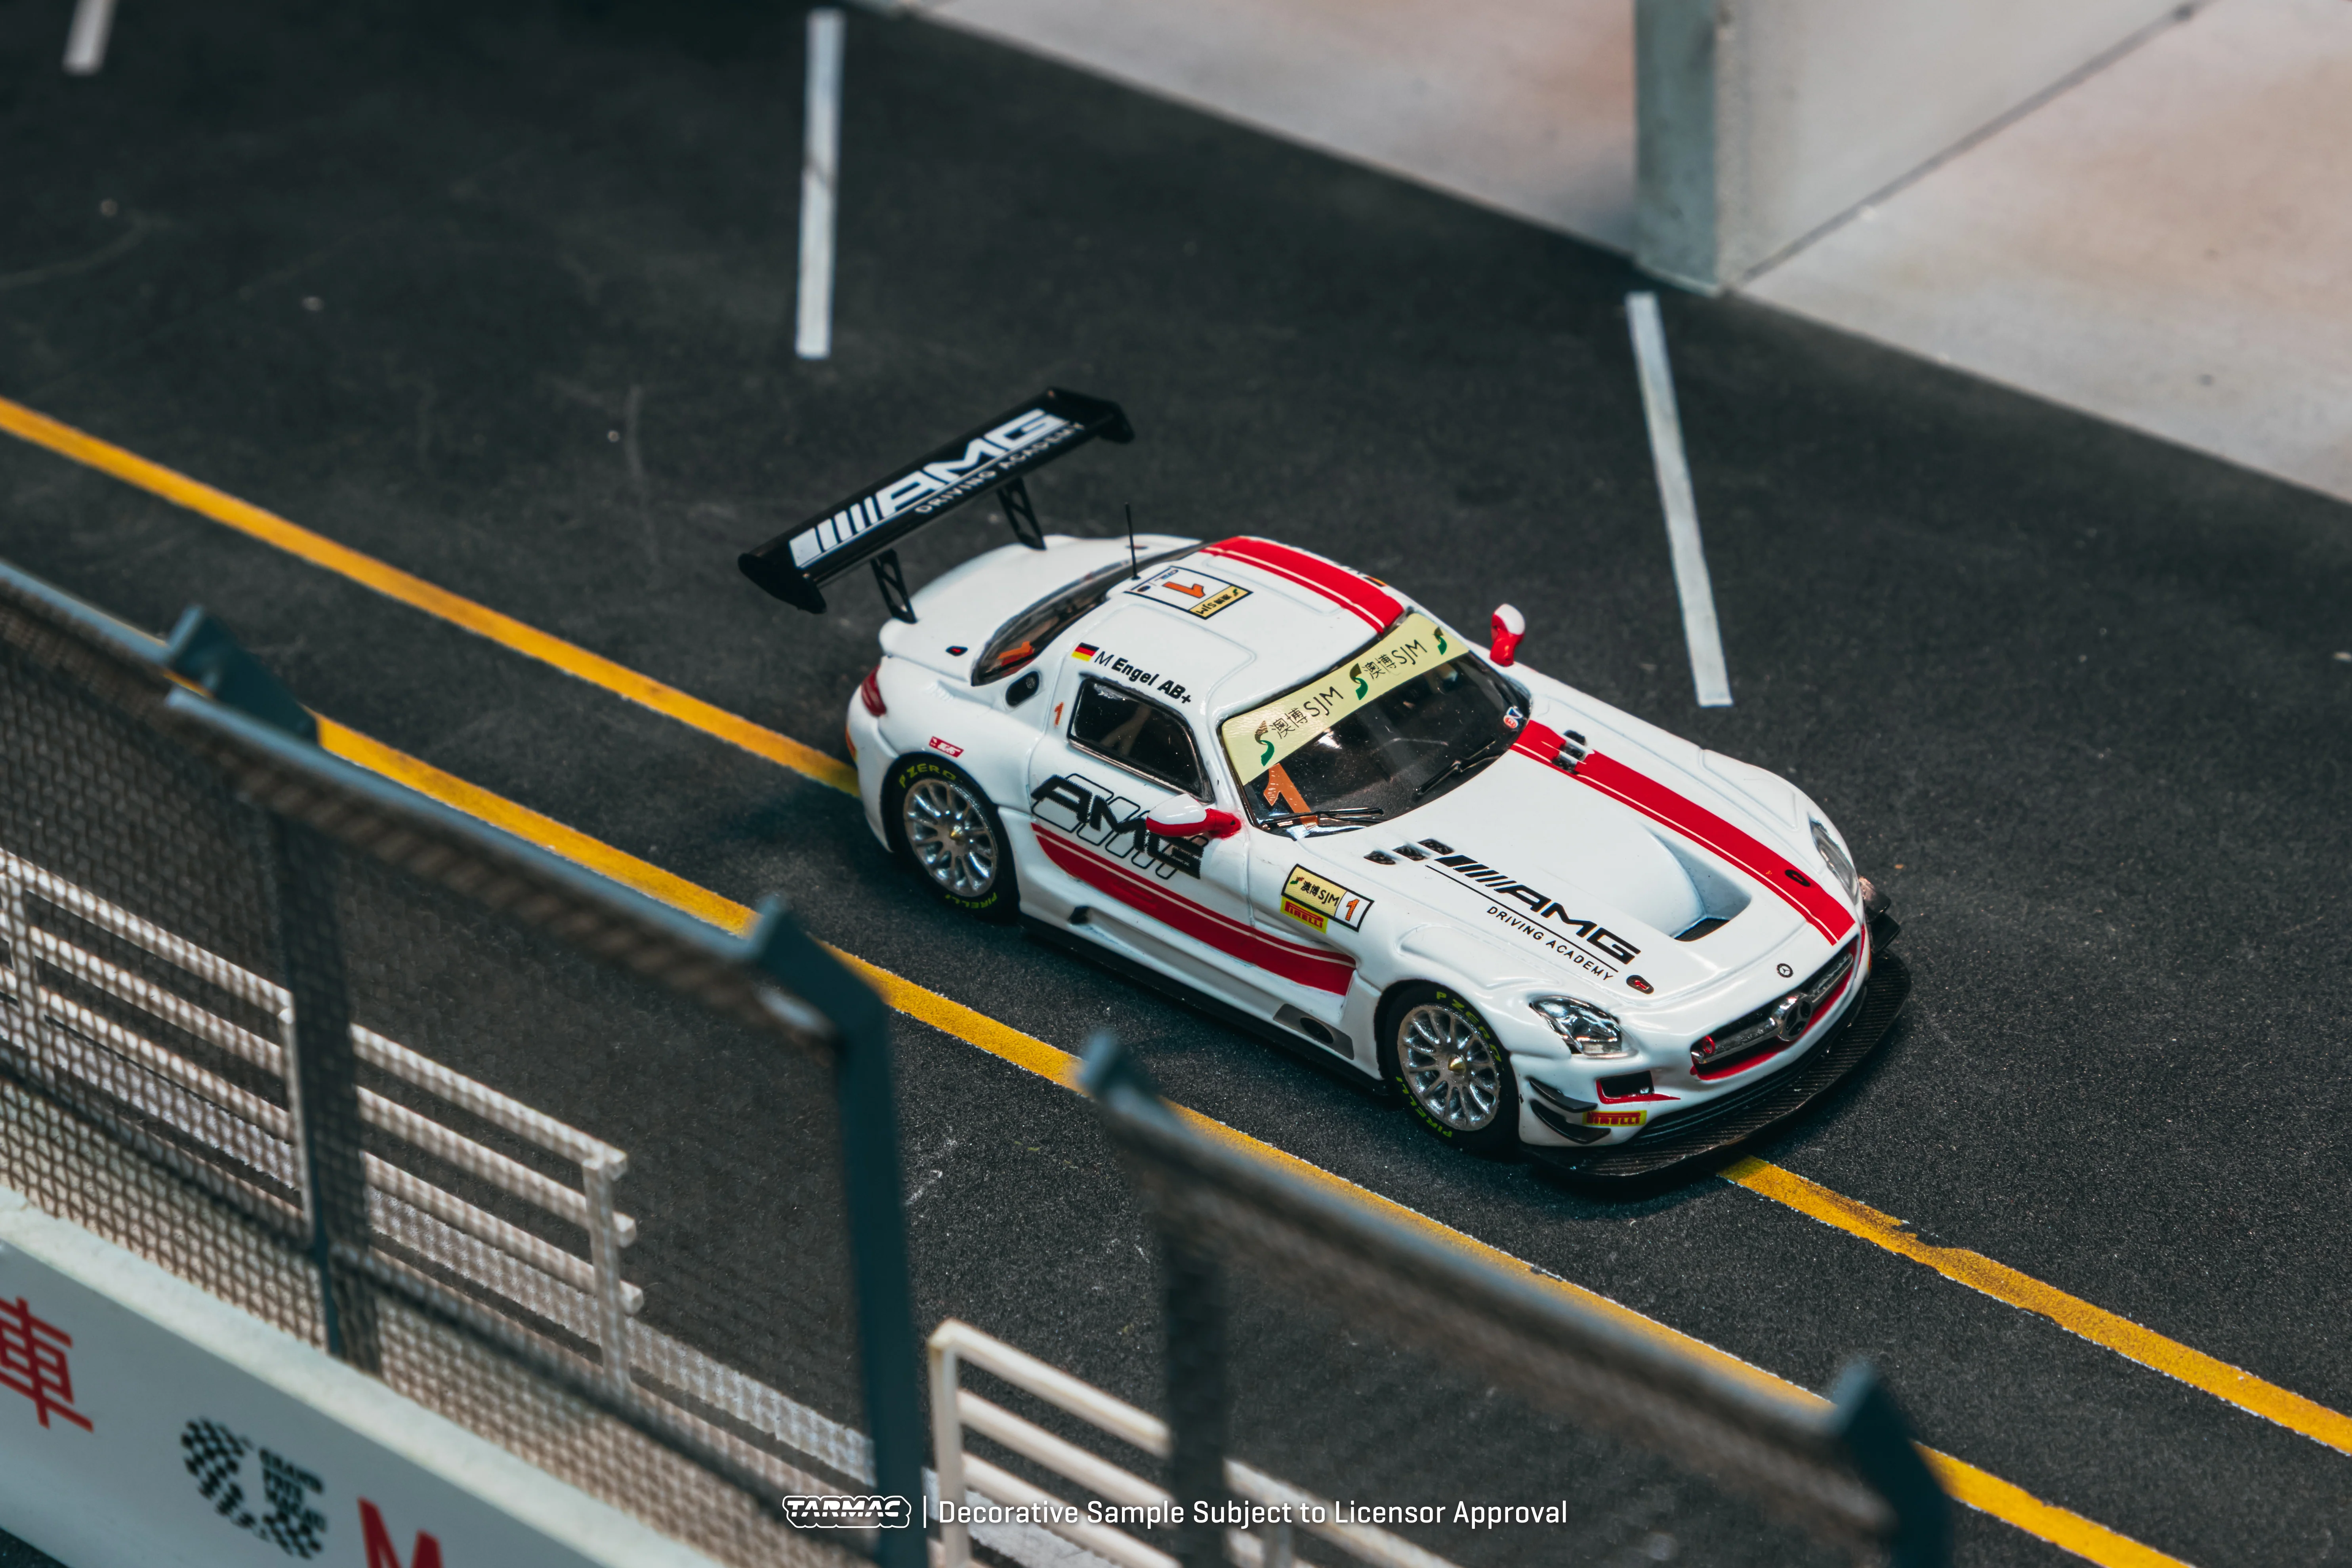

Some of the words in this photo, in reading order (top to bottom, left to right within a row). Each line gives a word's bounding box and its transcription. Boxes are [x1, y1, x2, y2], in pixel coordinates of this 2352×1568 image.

[915, 471, 997, 513] DRIVING
[998, 422, 1085, 469] ACADEMY
[1162, 581, 1206, 599] 1
[1391, 639, 1428, 665] SJM
[1094, 651, 1114, 666] M
[1111, 657, 1160, 686] Engel
[1157, 680, 1191, 704] AB+
[1055, 702, 1064, 725] 1
[1303, 686, 1344, 717] SJM
[906, 763, 956, 781] ZERO
[1031, 774, 1204, 880] AMG
[1318, 890, 1340, 906] SJM
[1345, 898, 1360, 921] 1
[1284, 900, 1324, 929] PIRELLI
[1486, 906, 1544, 940] DRIVING
[1546, 940, 1615, 981] ACADEMY
[1436, 991, 1447, 1000] P
[1452, 998, 1502, 1062] ZERO
[1396, 1076, 1453, 1138] PIRELLI
[1587, 1112, 1641, 1125] PIRELLI
